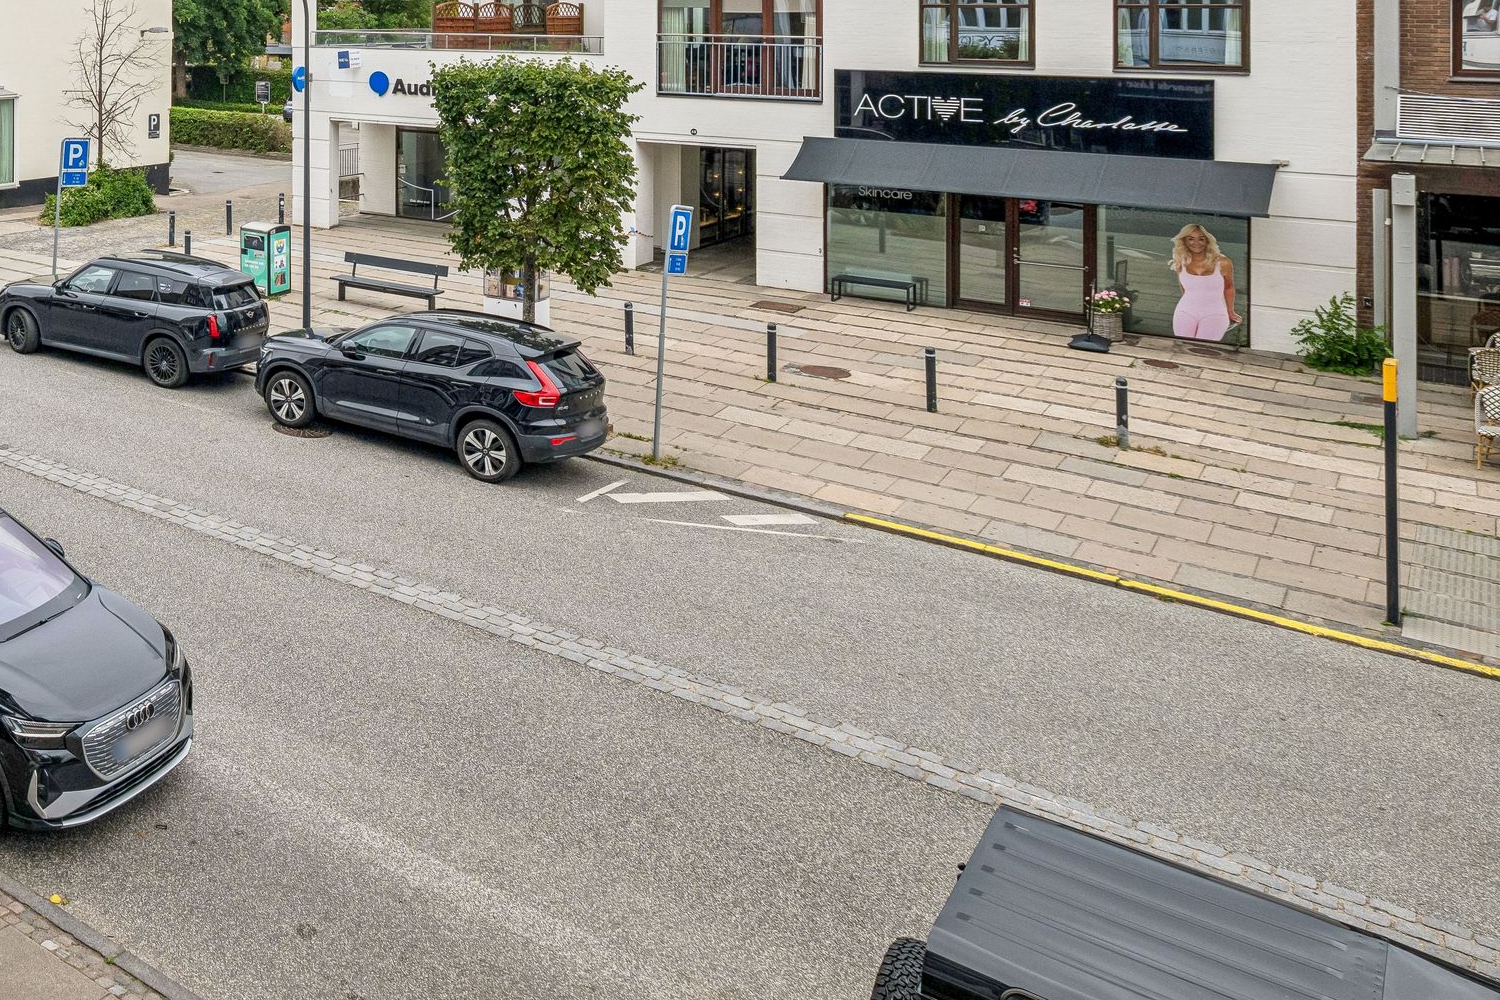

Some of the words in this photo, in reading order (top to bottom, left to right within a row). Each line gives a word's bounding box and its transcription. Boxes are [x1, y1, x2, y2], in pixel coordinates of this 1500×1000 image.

[150, 115, 158, 130] P
[854, 93, 984, 122] ACTIVE
[994, 108, 1030, 133] by
[1037, 102, 1188, 132] Charlotte
[68, 143, 83, 166] P
[858, 185, 913, 200] Skincare
[674, 215, 687, 246] P
